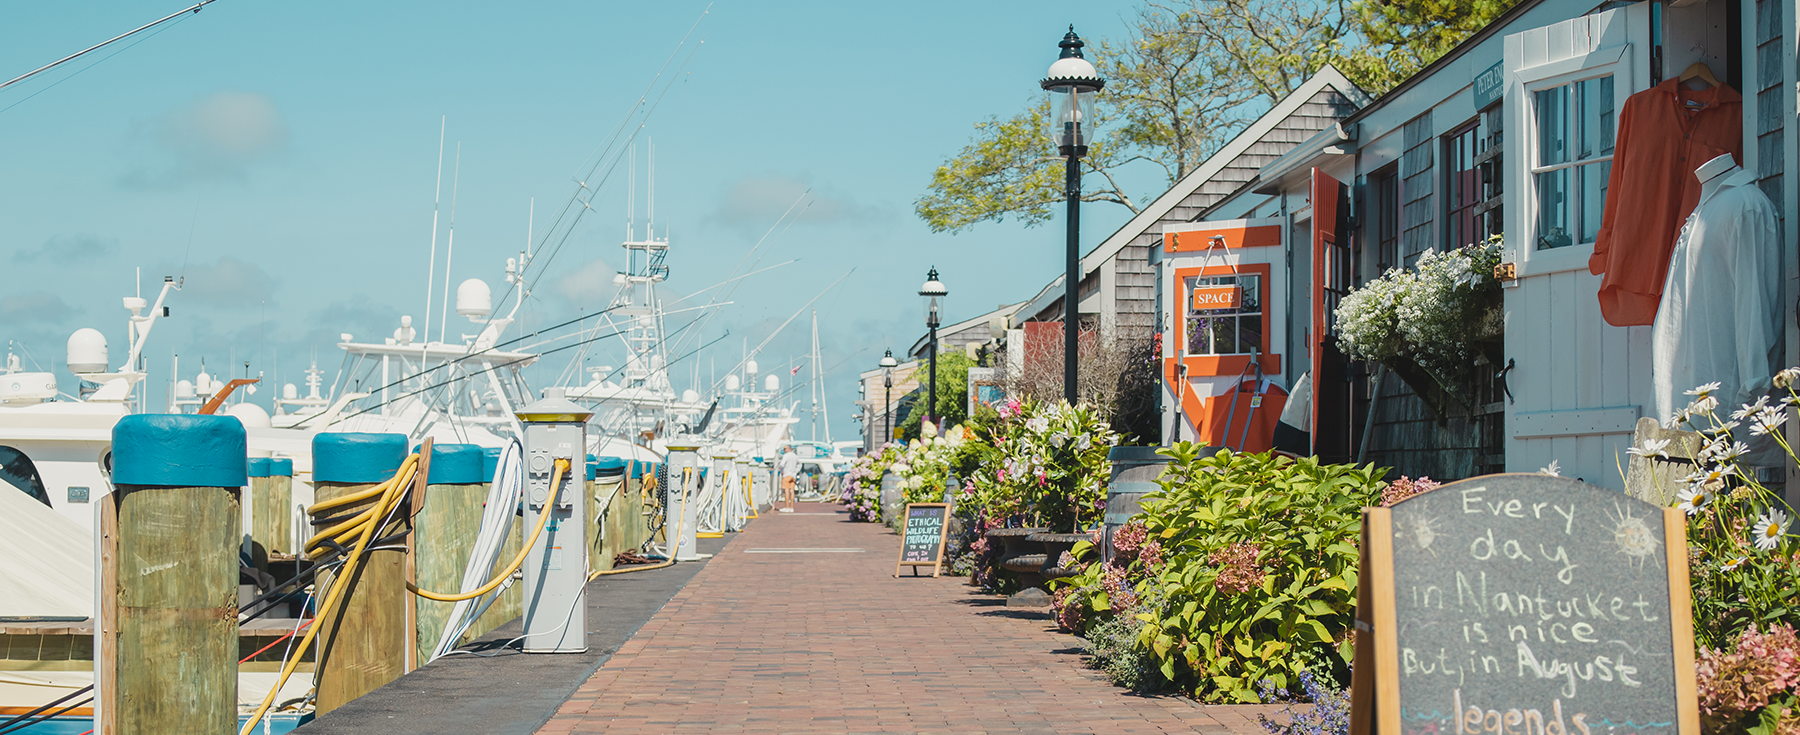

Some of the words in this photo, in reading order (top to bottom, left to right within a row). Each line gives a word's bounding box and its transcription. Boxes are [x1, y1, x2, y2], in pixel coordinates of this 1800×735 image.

[1477, 70, 1494, 95] PETER
[1198, 292, 1235, 304] SPACE
[908, 517, 943, 527] ETHICAL
[1460, 486, 1575, 535] Every
[906, 526, 940, 535] WILDLIFE
[1470, 528, 1578, 585] day
[1412, 576, 1444, 610] in
[1455, 570, 1659, 622] Nantucket
[1462, 618, 1489, 643] is
[1508, 620, 1599, 644] nice
[1470, 650, 1501, 674] in
[1516, 641, 1643, 699] August
[1454, 687, 1591, 735] legends
